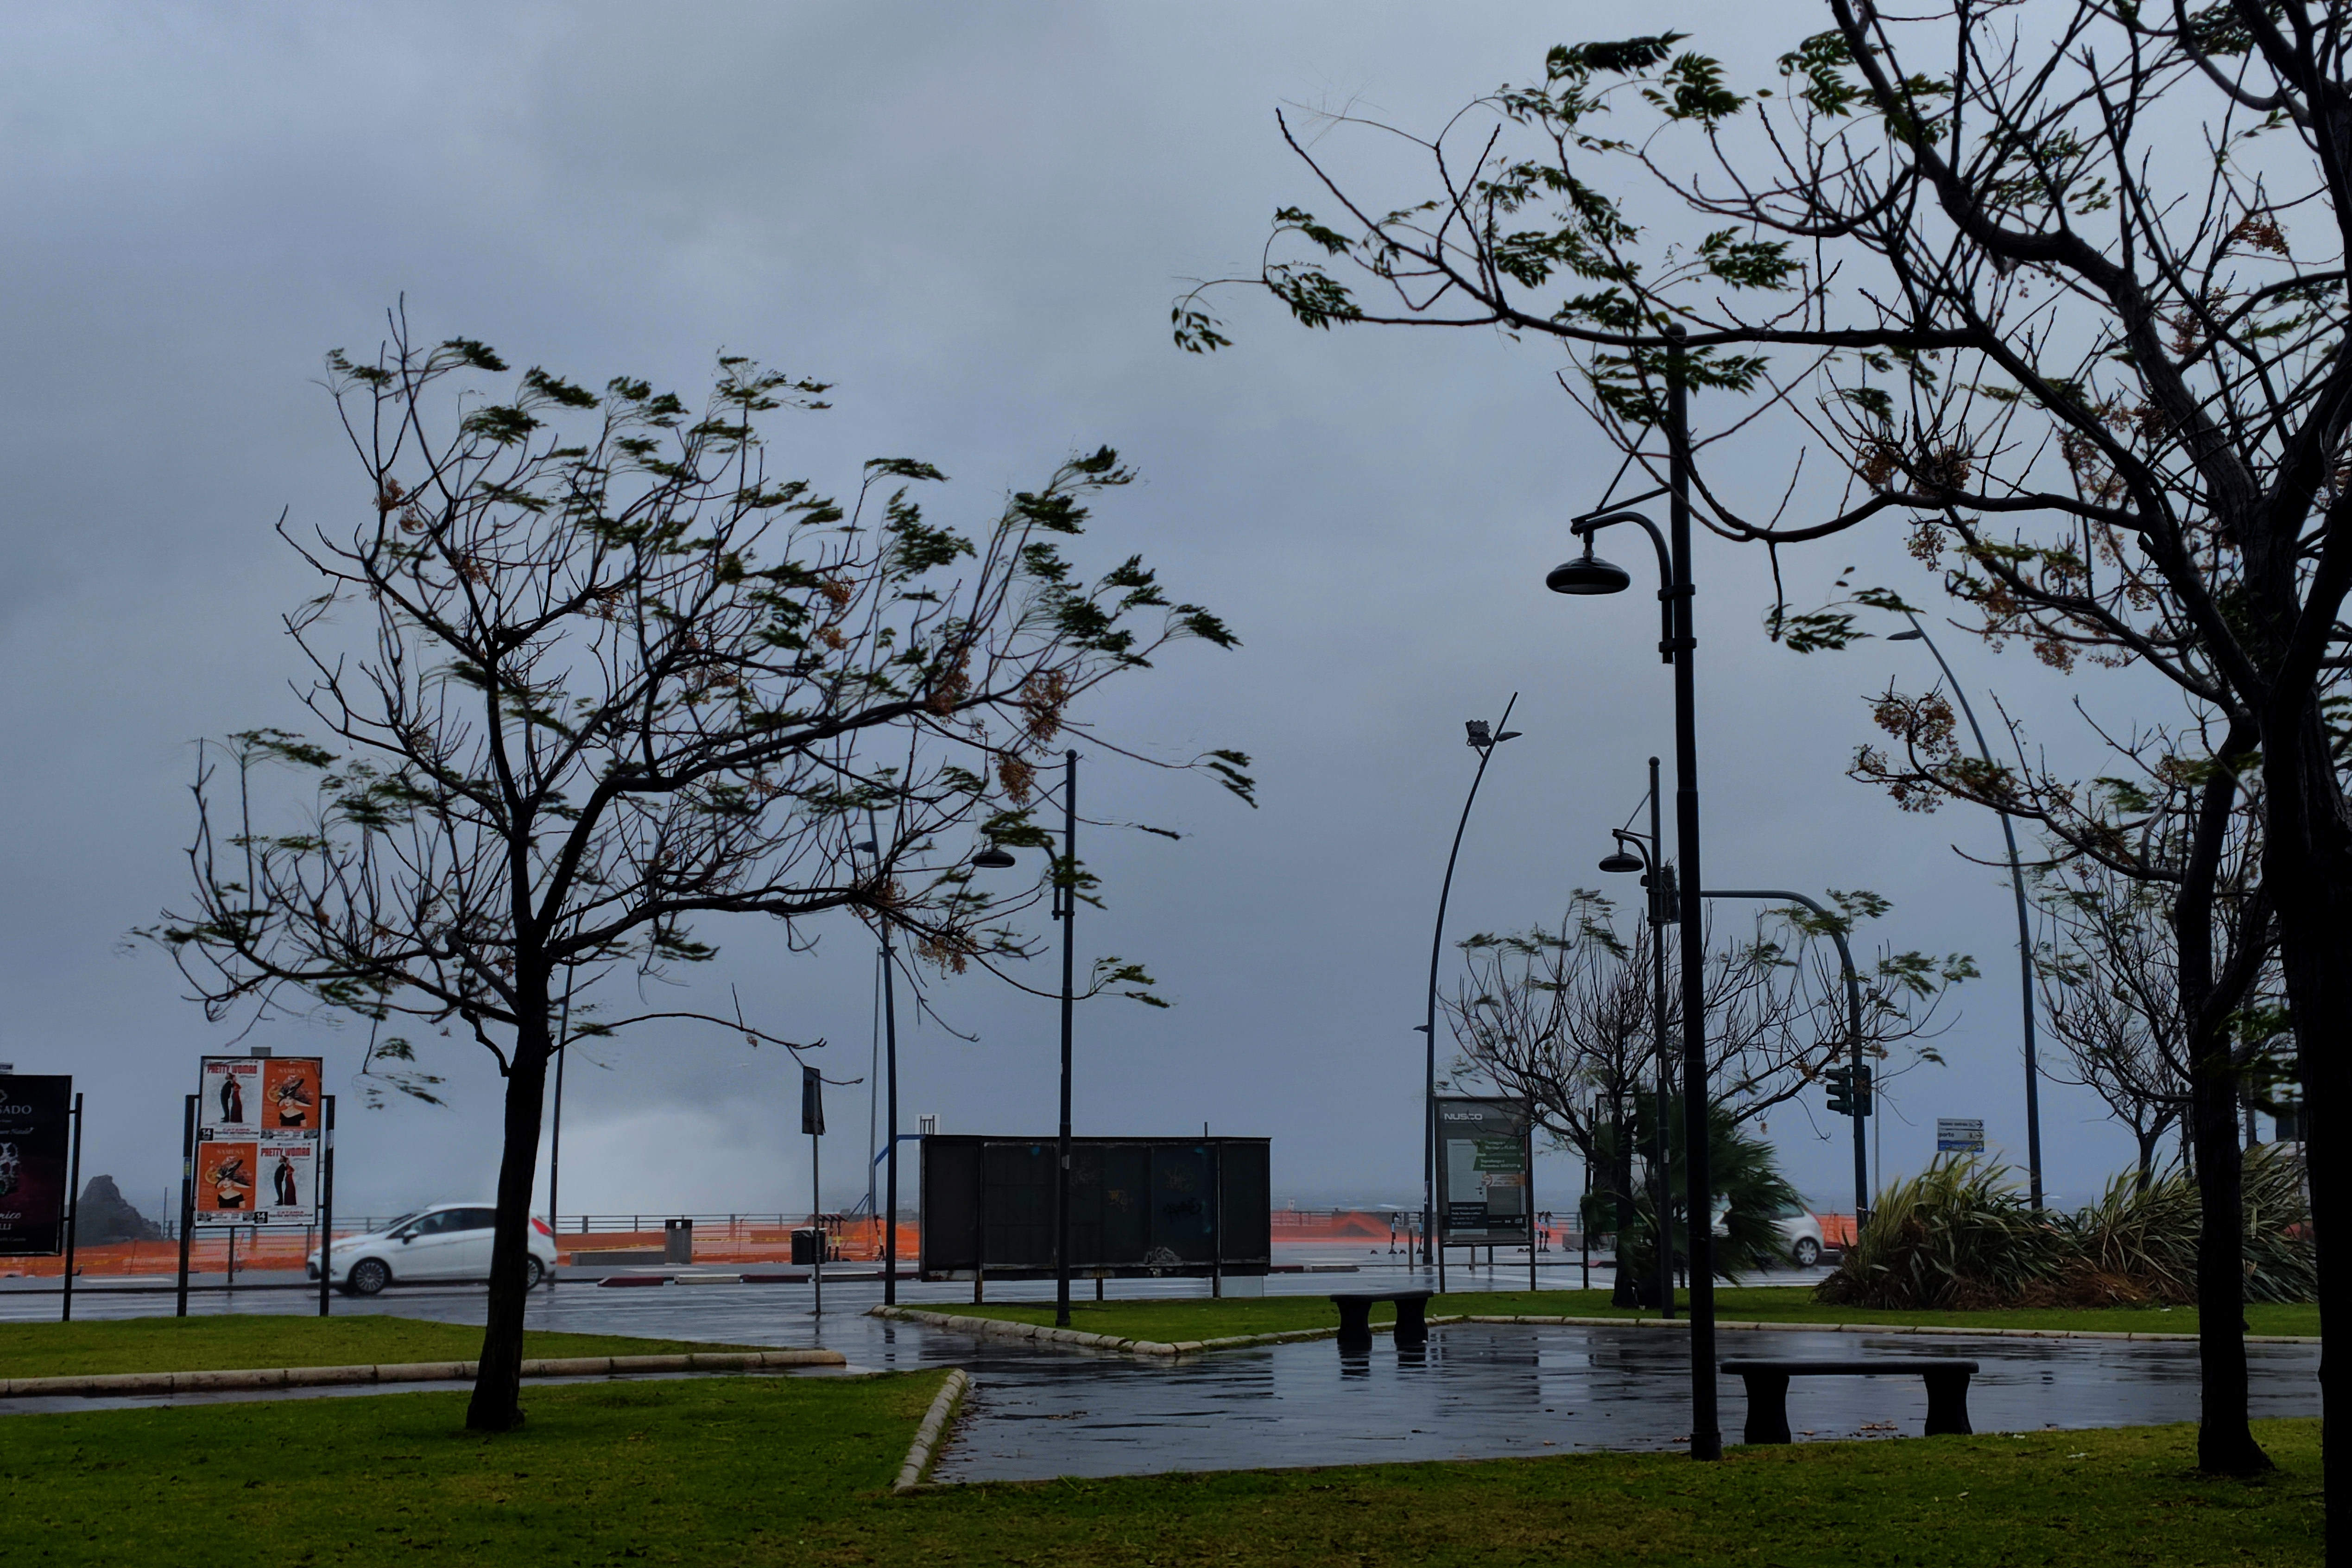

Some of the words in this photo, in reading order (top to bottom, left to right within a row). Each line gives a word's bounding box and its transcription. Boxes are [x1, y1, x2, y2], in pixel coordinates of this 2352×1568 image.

[208, 1065, 230, 1074] PRETTY
[232, 1065, 257, 1074] WOMAN
[260, 1148, 284, 1157] PRETTY
[285, 1148, 310, 1157] WOMAN
